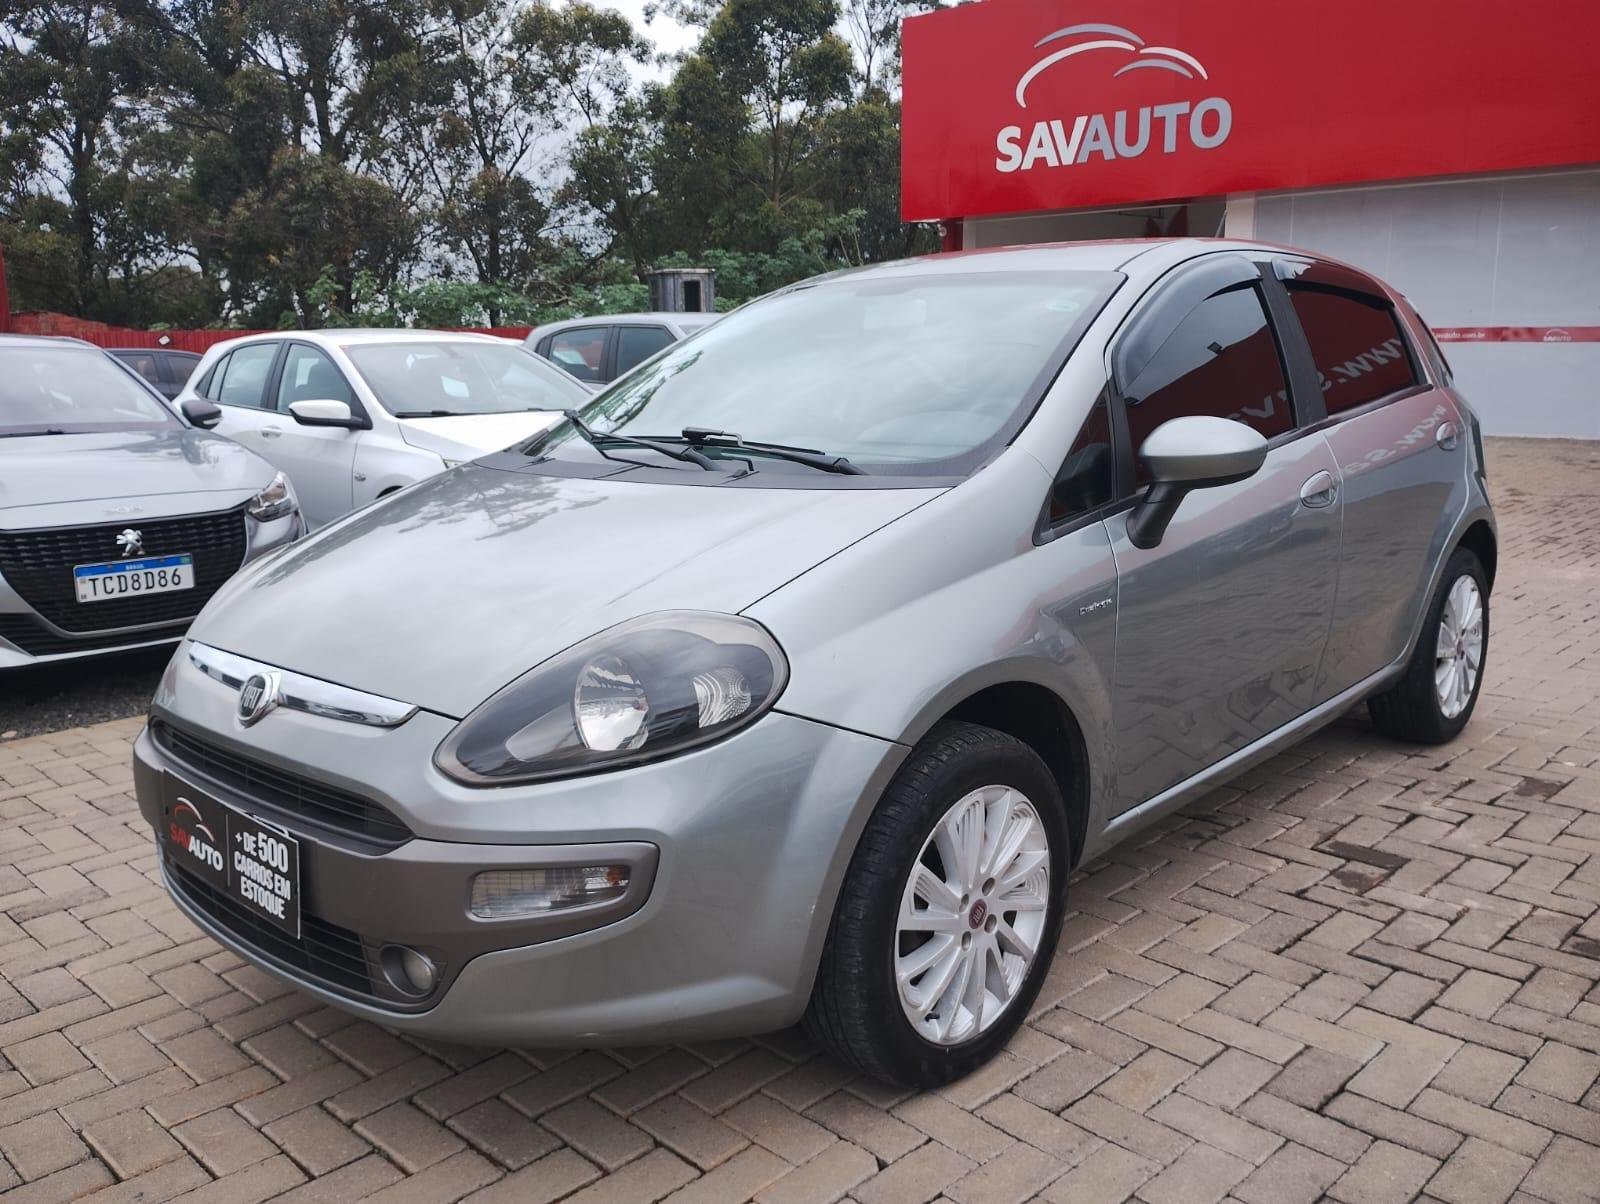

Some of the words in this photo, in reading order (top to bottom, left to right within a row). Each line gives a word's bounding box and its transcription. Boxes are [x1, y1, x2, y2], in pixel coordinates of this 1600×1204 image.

[996, 97, 1233, 173] SAVAUTO
[88, 568, 182, 596] TCD8D86
[170, 822, 224, 871] SAVAUTO
[243, 832, 257, 857] DE
[258, 831, 289, 873] 500
[234, 850, 274, 890] CARROS
[274, 873, 291, 901] EM
[240, 875, 286, 920] ESTOQUE
